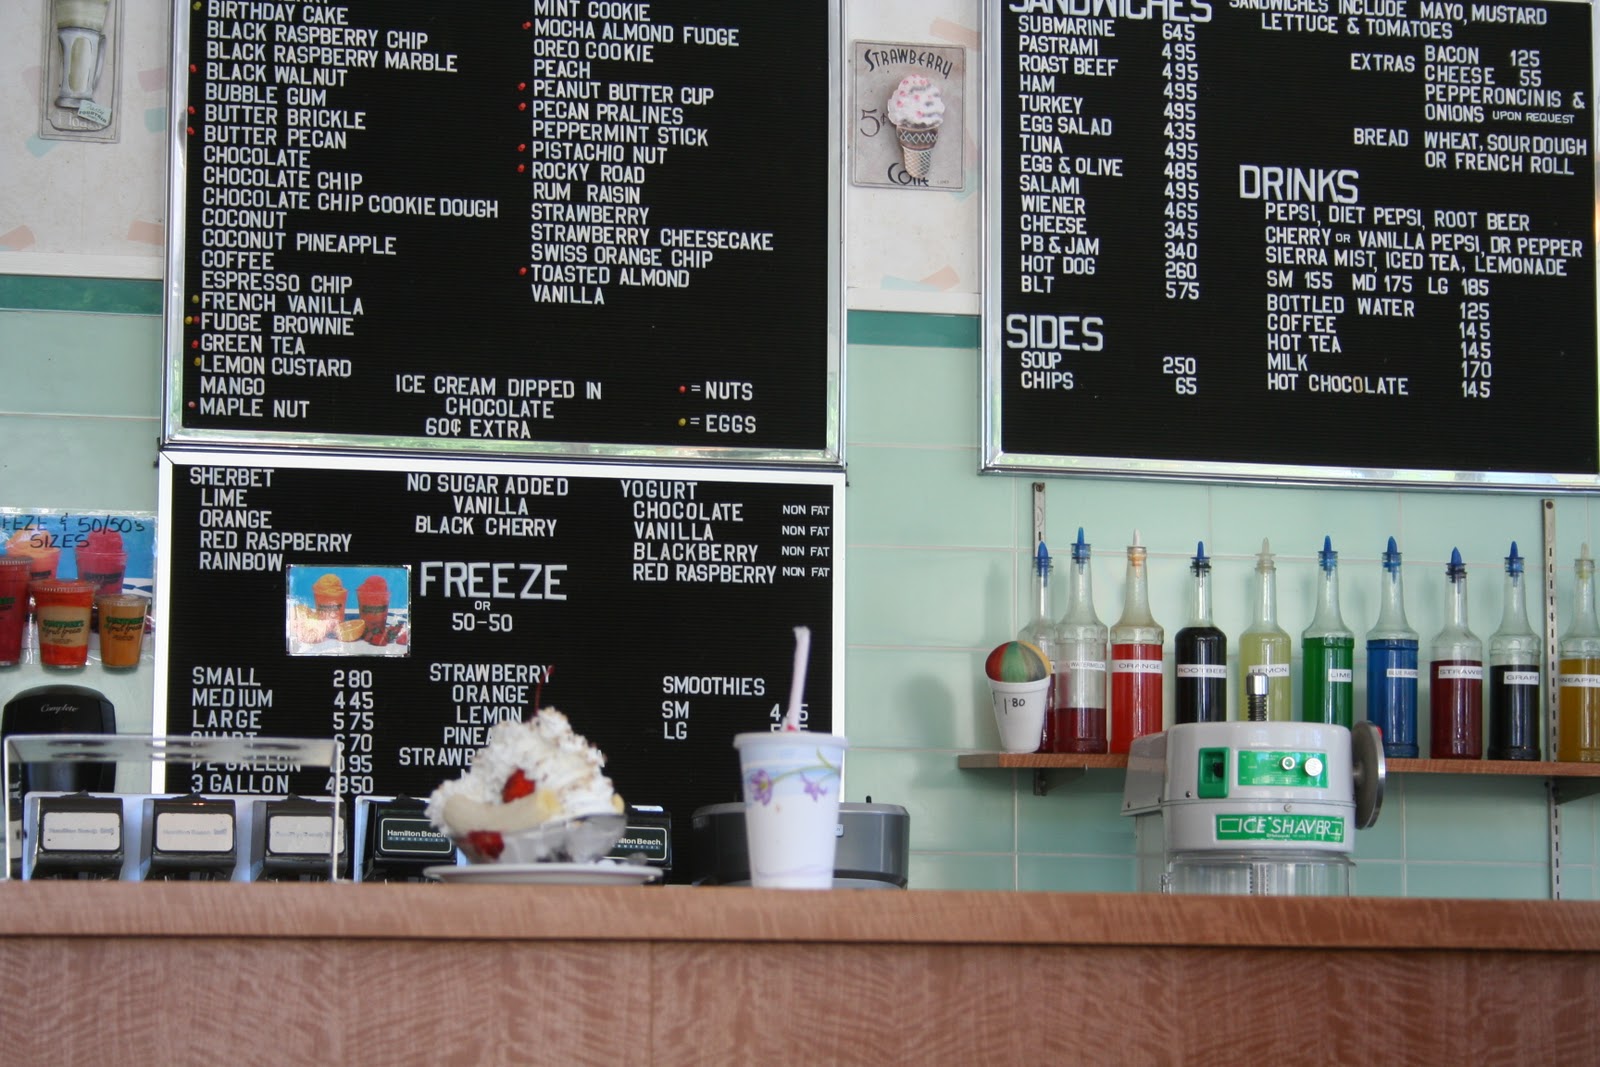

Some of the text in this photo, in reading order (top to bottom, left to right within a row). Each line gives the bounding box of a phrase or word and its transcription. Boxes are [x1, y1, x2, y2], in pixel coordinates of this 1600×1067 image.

[208, 0, 348, 25] BIRTHDAY CAKE
[534, 0, 651, 22] MINT COOKIE
[1018, 14, 1195, 42] SUBMARINE 645
[1261, 12, 1453, 40] LETTUCE & TOMATOES
[207, 41, 458, 72] BLACK RASPBERRY MARBLE
[864, 48, 953, 79] STRAWBERRY
[1351, 53, 1415, 73] EXTRAS
[1425, 45, 1540, 67] BACON 125
[534, 59, 590, 79] PEACH
[205, 82, 326, 107] BUBBLE GUM
[534, 79, 714, 105] PEANUT BUTTER CUP
[1020, 74, 1197, 101] HAM 495
[1425, 103, 1575, 124] ONIONS UPON REQUEST
[204, 125, 346, 149] BUTTER PECAN
[533, 120, 708, 146] PEPPERMINT STICK
[1020, 114, 1196, 140] EGG SALAD 435
[532, 161, 645, 184] ROCKY ROAD
[1425, 150, 1574, 175] OR FRENCH ROLL
[1239, 164, 1359, 204] DRINKS
[203, 187, 498, 218] CHOCOLATE CHIP COOKIE DOUGH
[1021, 194, 1198, 220] WIENER 465
[203, 228, 397, 255] COCONUT PINEAPPLE
[531, 223, 774, 251] STRAWBERRY CHEESECAKE
[1265, 226, 1583, 258] CHERRY OR VANILLA PEPSI, DR PEPPER
[1021, 254, 1197, 280] HOT DOG 260
[202, 270, 352, 294] ESPRESSO CHIP
[1267, 269, 1489, 296] SM 155 MD 175 LG 185
[202, 291, 364, 315] FRENCH VANILLA
[1006, 314, 1103, 351] SIDES
[201, 333, 305, 355] GREEN TEA
[706, 381, 753, 401] NUTS
[1021, 370, 1197, 395] CHIPS 65
[200, 397, 310, 418] MAPLE NUT
[425, 417, 531, 439] 60¢ EXTRA
[706, 414, 756, 433] EGGS
[190, 466, 275, 487] SHERBET
[407, 473, 568, 496] NO SUGAR ADDED
[201, 488, 247, 507] LIME
[620, 479, 698, 500] YOGURT
[453, 495, 528, 515] VANILLA
[633, 500, 830, 522] CHOCOLATE NON FAT
[199, 509, 272, 529] ORANGE
[415, 515, 557, 537] BLACK CHERRY
[30, 533, 90, 548] SIZES
[200, 530, 352, 552] RED RASPBERRY
[634, 521, 830, 541] VANILLA NON FAT
[200, 551, 283, 572] RAINBOW
[633, 542, 830, 563] BLACKBERRY NON FAT
[420, 561, 567, 600] FREEZE
[633, 562, 830, 584] RED RASPBERRY NON FAT
[474, 600, 491, 611] OR
[452, 612, 513, 632] 50-50
[193, 666, 261, 686] SMALL
[430, 663, 549, 683] STRAWBERRY
[1118, 662, 1160, 670] ORANGE
[1330, 671, 1351, 679] LIME
[452, 684, 529, 704] ORANGE
[663, 676, 765, 696] SMOOTHIES
[192, 688, 273, 707] MEDIUM
[193, 709, 262, 729] LARGE
[456, 705, 522, 724] LEMON
[662, 700, 689, 719] SM
[664, 721, 687, 740] LG
[191, 774, 289, 793] 3 GALLON
[1238, 817, 1332, 835] ICE SHAVER
